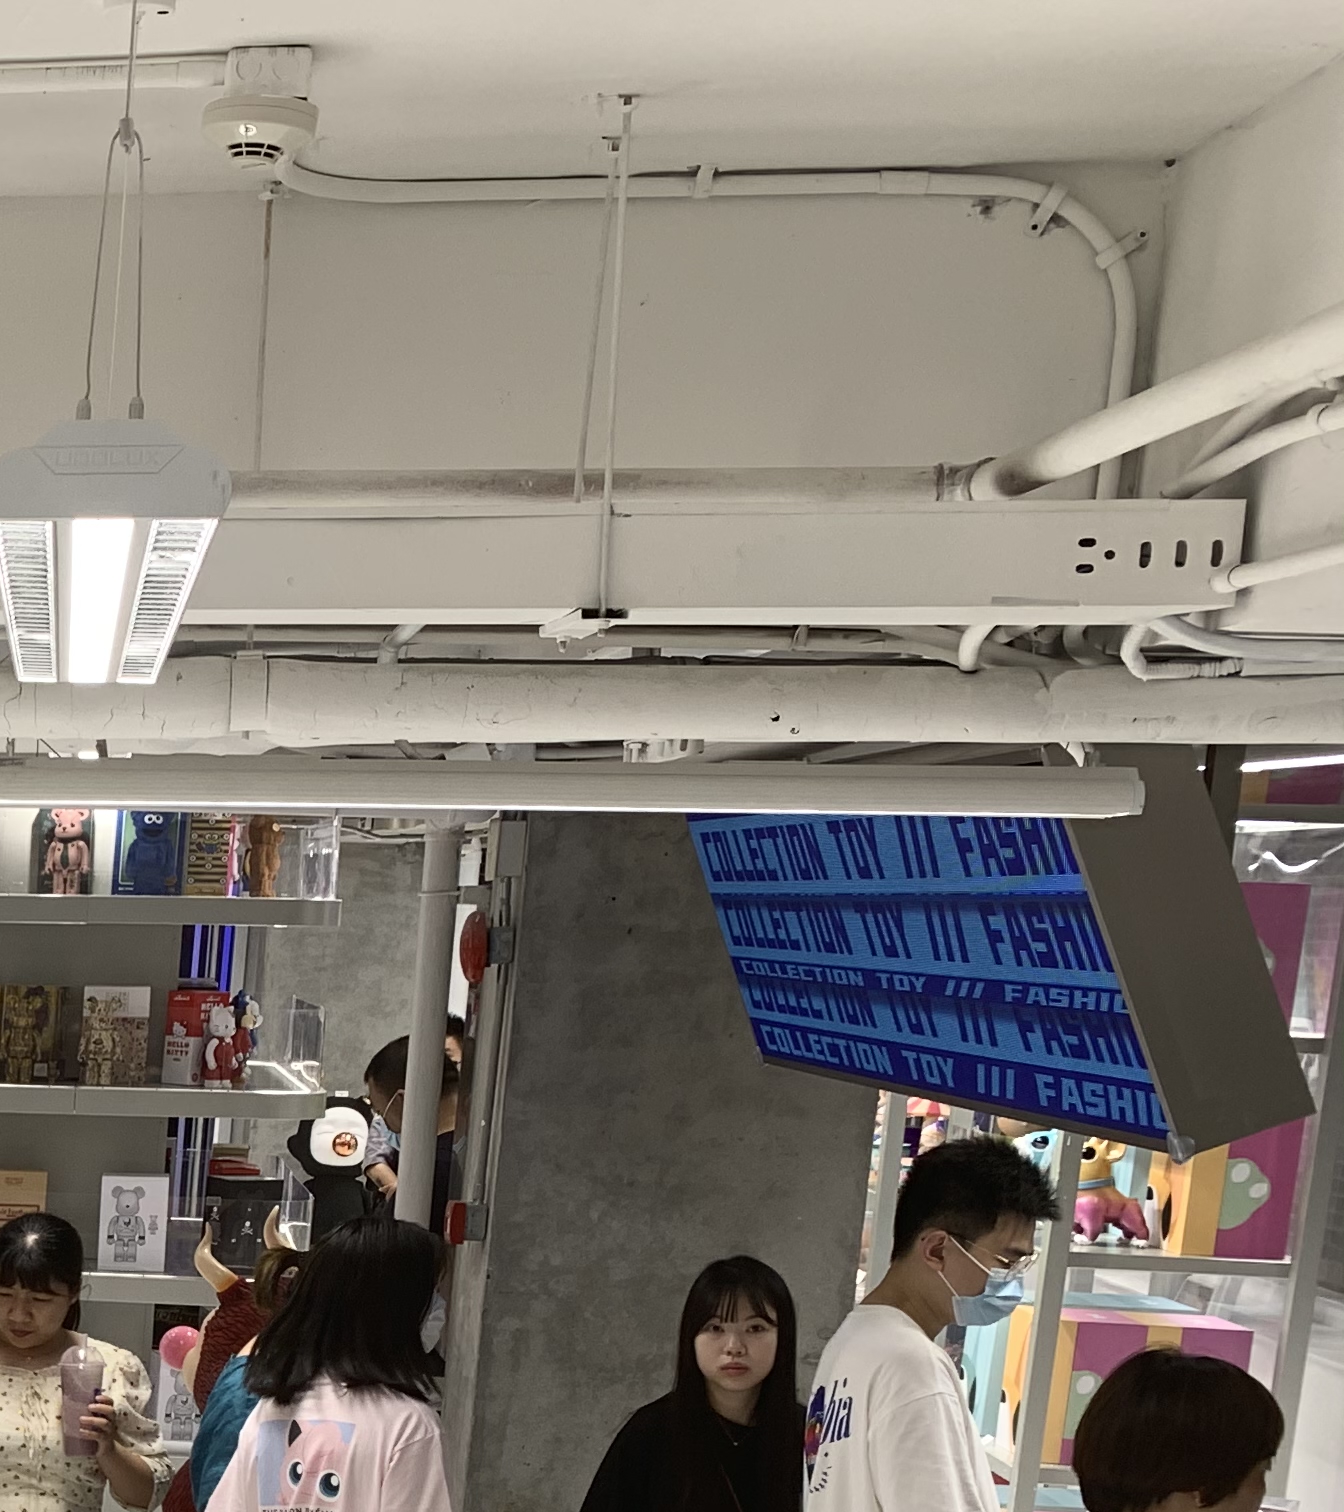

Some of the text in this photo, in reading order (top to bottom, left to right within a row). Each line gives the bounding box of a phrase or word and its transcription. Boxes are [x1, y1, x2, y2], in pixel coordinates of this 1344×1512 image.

[700, 823, 829, 882] COLLECTION
[826, 817, 885, 880] TOY
[721, 898, 853, 955] COLLECTION
[852, 898, 912, 959] TOY
[740, 960, 864, 987] COLLECTION
[877, 973, 927, 993] TOY
[761, 1024, 893, 1075] COLLECTION
[901, 1050, 955, 1088] TOY
